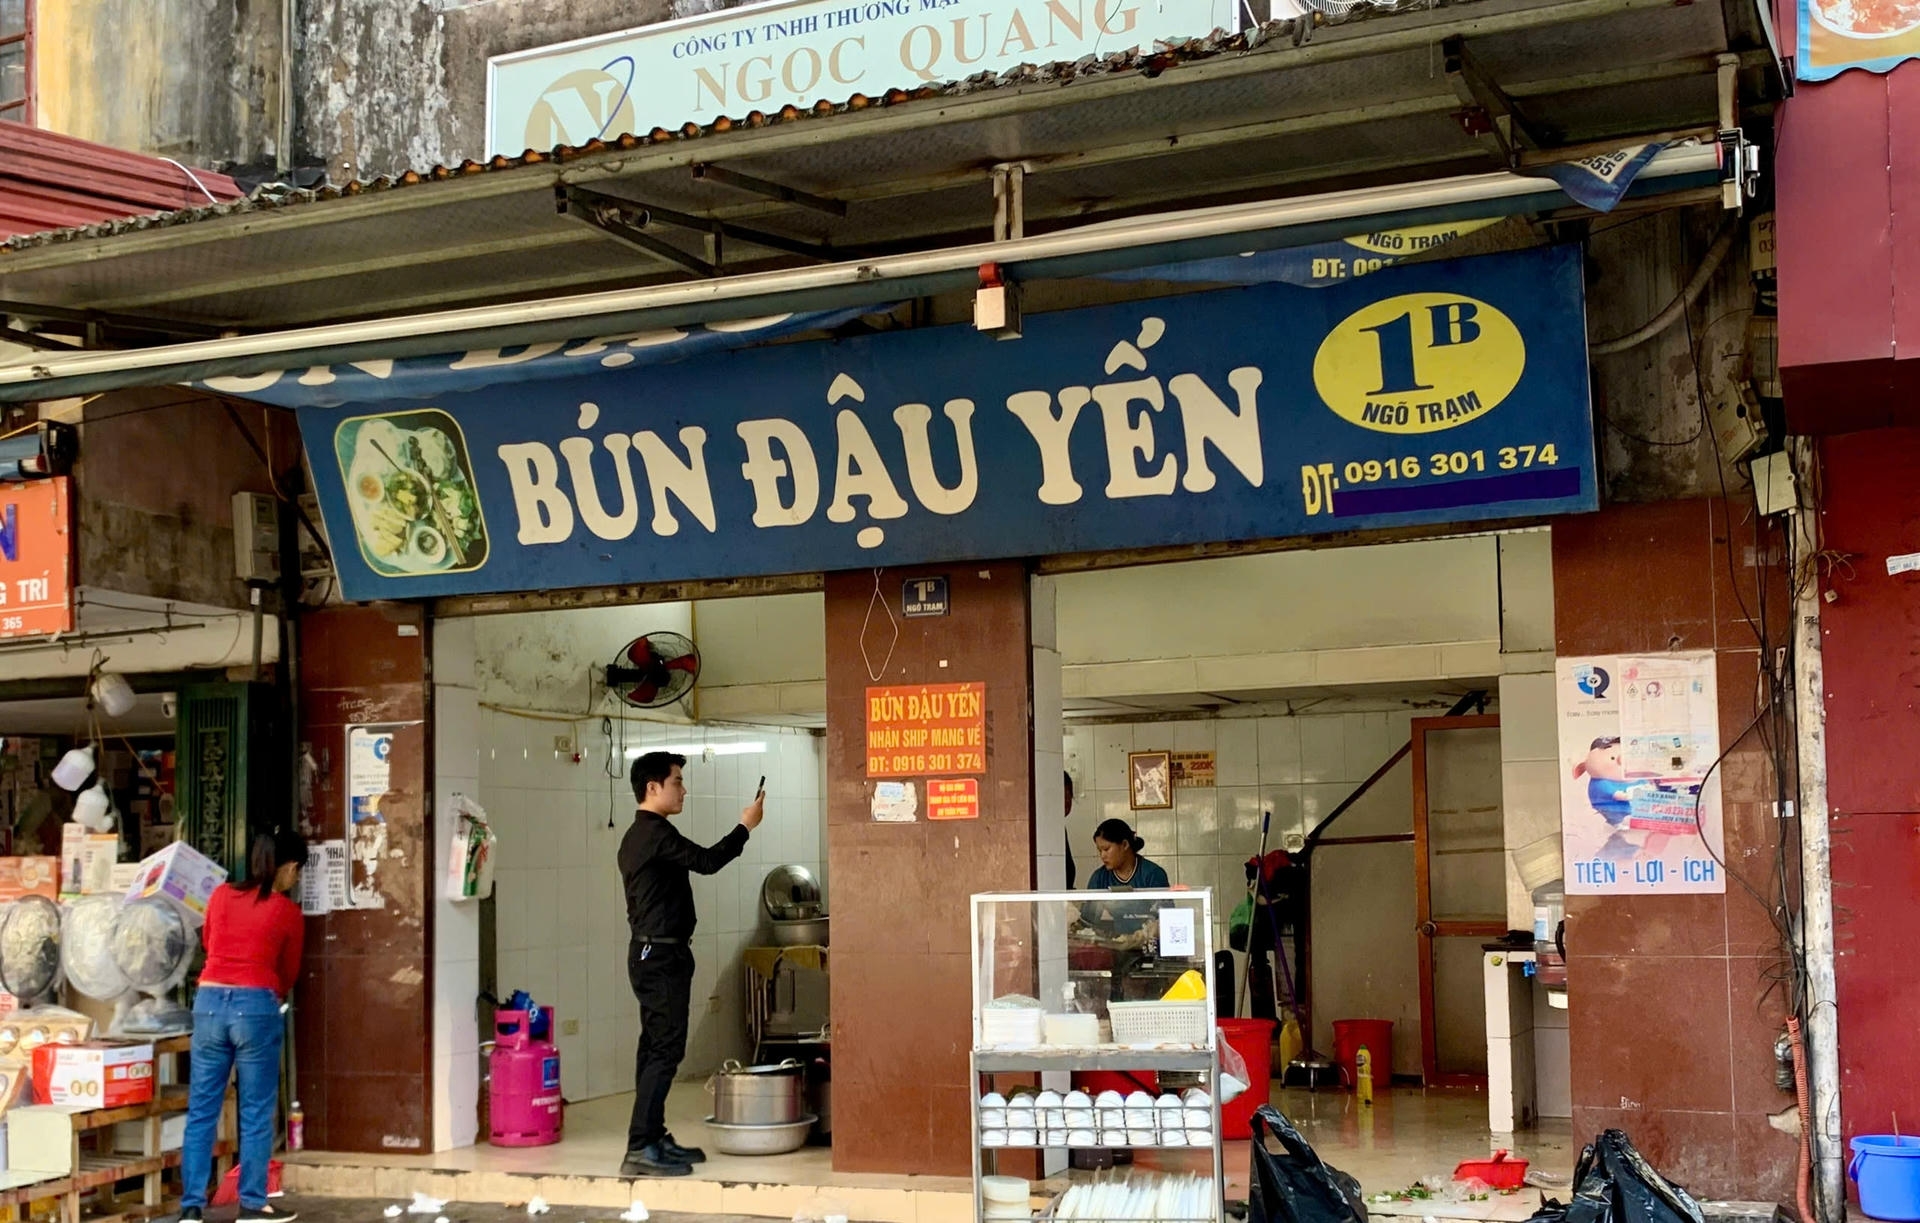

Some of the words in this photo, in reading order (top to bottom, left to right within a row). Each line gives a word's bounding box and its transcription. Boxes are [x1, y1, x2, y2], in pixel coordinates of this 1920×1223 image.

[673, 34, 727, 59] CÔNG
[732, 28, 757, 48] TY
[763, 15, 818, 41] TNHH
[824, 0, 910, 28] THƯƠNG
[693, 35, 867, 112] NGỌC
[899, 0, 1137, 80] QUANG
[1312, 258, 1346, 278] ĐT:
[1361, 401, 1409, 426] NGÕ
[1416, 390, 1483, 424] TRẠM
[498, 402, 717, 546] BÚN
[736, 372, 979, 549] ĐẬU
[1006, 317, 1264, 505] YẾN
[1344, 456, 1421, 484] 0916
[1430, 450, 1485, 476] 301
[1498, 443, 1558, 469] 374
[17, 569, 49, 603] TRÍ
[3, 616, 23, 630] 365
[870, 690, 904, 722] BÚN
[908, 687, 943, 724] ĐẬU
[947, 683, 981, 718] YẾN
[869, 726, 899, 752] NHẬN
[902, 729, 928, 748] SHIP
[931, 728, 964, 747] MANG
[869, 756, 889, 772] ĐT:
[893, 754, 925, 772] 0916
[929, 754, 952, 770] 301
[957, 752, 981, 770] 374
[1574, 858, 1616, 888] TIỆN
[1636, 859, 1664, 887] LỢI
[1684, 856, 1715, 882] ÍCH
